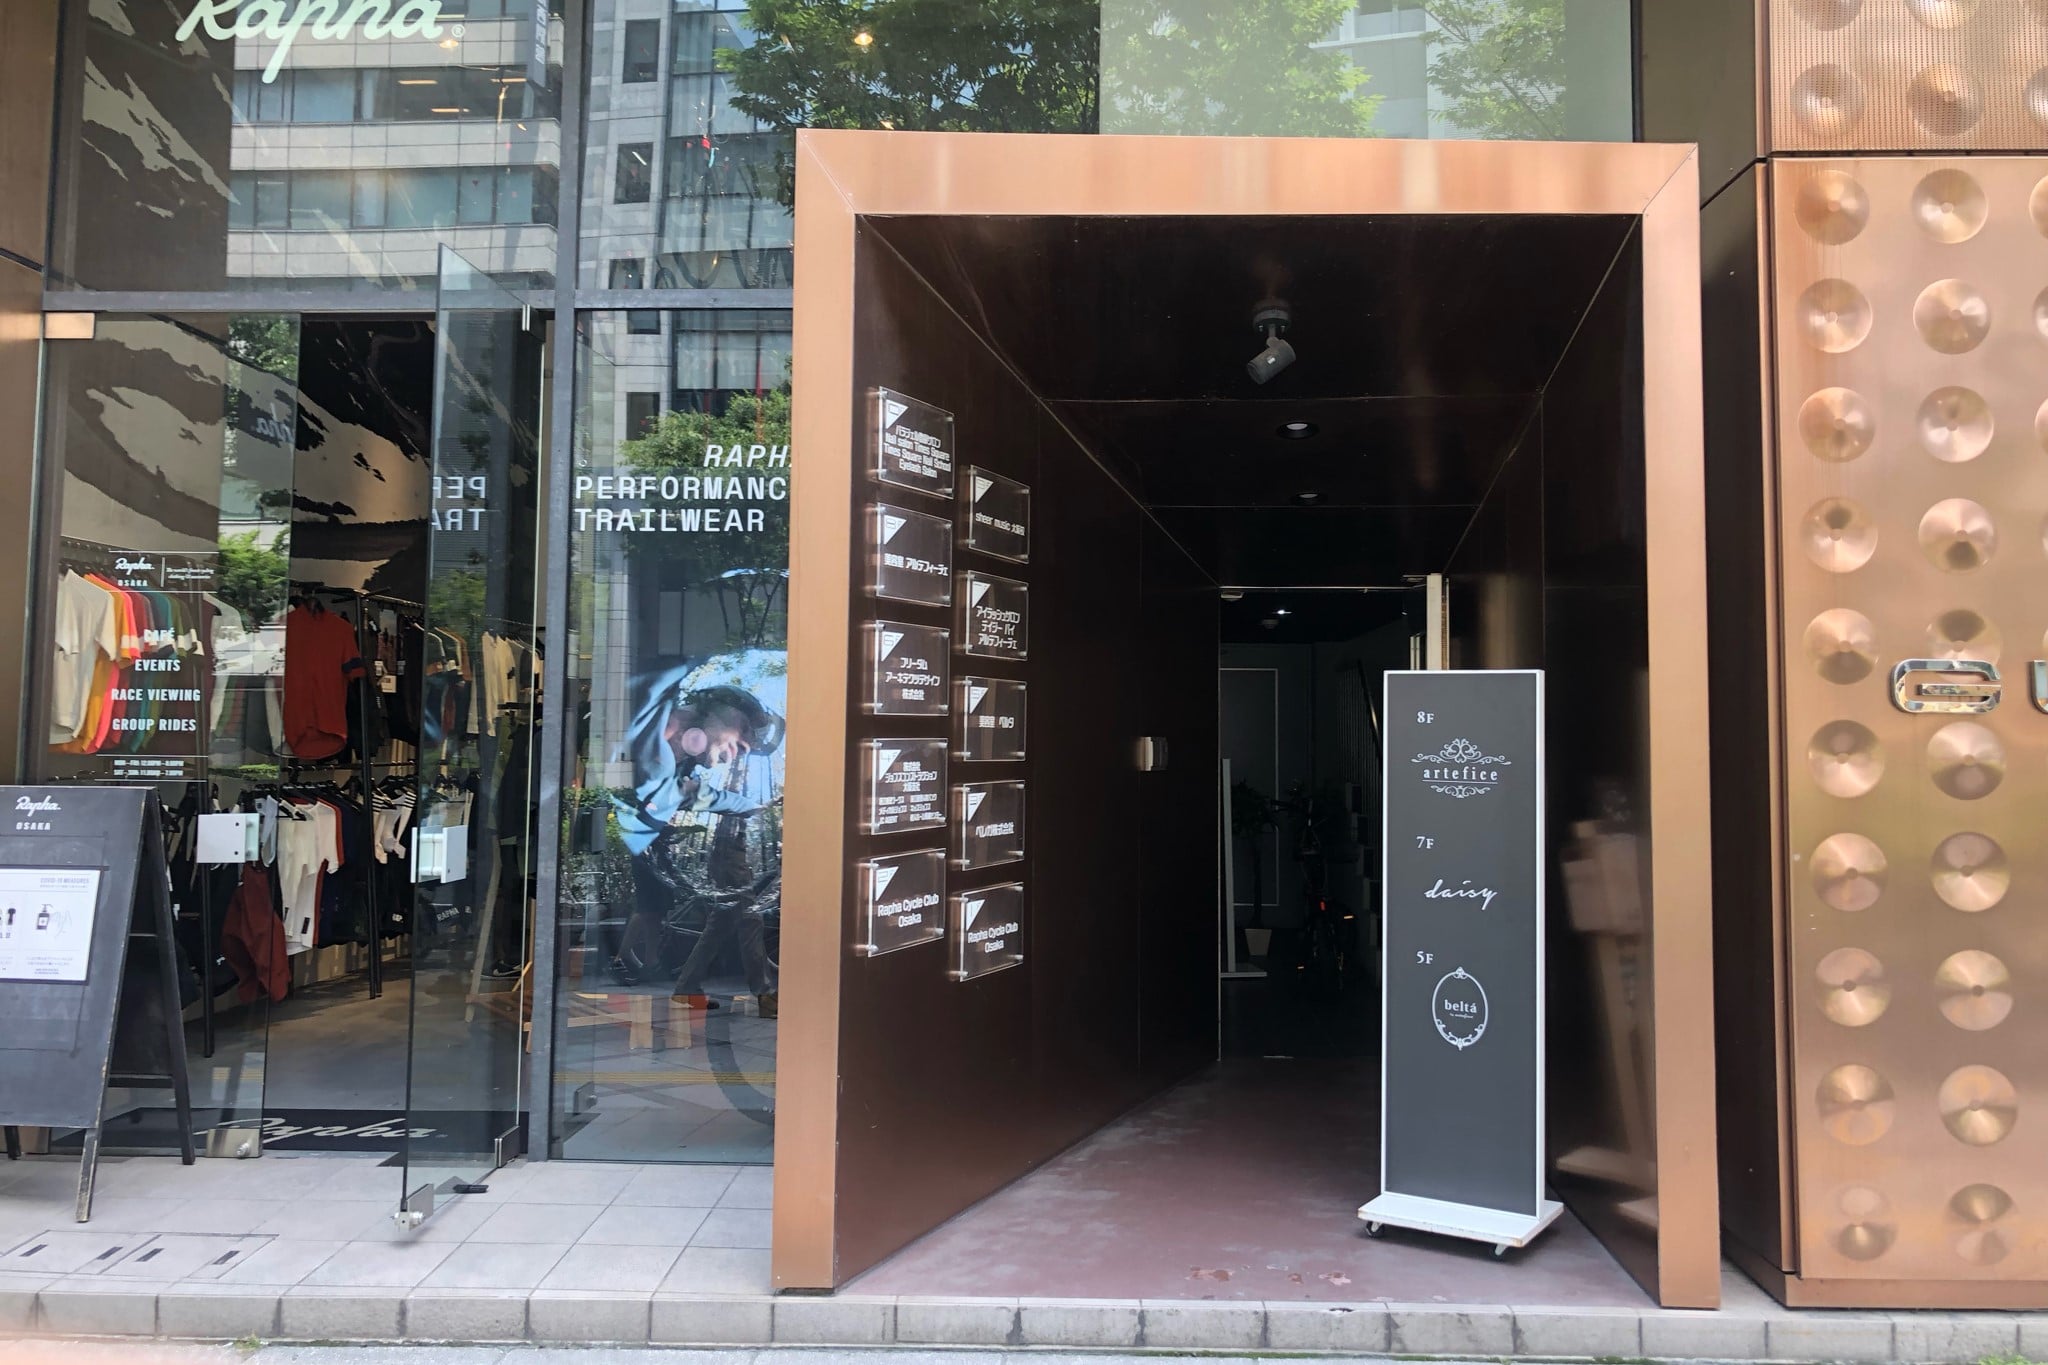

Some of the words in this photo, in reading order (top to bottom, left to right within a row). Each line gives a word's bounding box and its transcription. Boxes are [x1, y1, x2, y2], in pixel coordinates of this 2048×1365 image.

[703, 444, 791, 468] RAPH
[575, 476, 788, 500] PERFORMANC
[575, 508, 765, 533] TRAILWEAR
[118, 579, 148, 587] OSAKA
[135, 659, 181, 672] EVENTS
[111, 688, 143, 701] RACE
[147, 688, 201, 702] VIEWING
[1416, 711, 1434, 723] 8F
[112, 718, 155, 732] GROUP
[158, 718, 197, 732] RIDES
[1423, 766, 1498, 780] artefice
[15, 795, 62, 817] Rapha
[16, 822, 51, 831] OSAKA
[1416, 836, 1434, 849] 7F
[1424, 878, 1498, 911] daisy
[878, 900, 903, 917] Rapha
[902, 896, 923, 911] Cycle
[923, 893, 940, 907] Club
[898, 913, 922, 928] Osaka
[967, 929, 988, 944] Rapha
[988, 925, 1005, 938] Cycle
[1005, 922, 1019, 934] Club
[984, 940, 1005, 953] Osaka
[1416, 950, 1434, 964] 5F
[1444, 998, 1478, 1013] beltá
